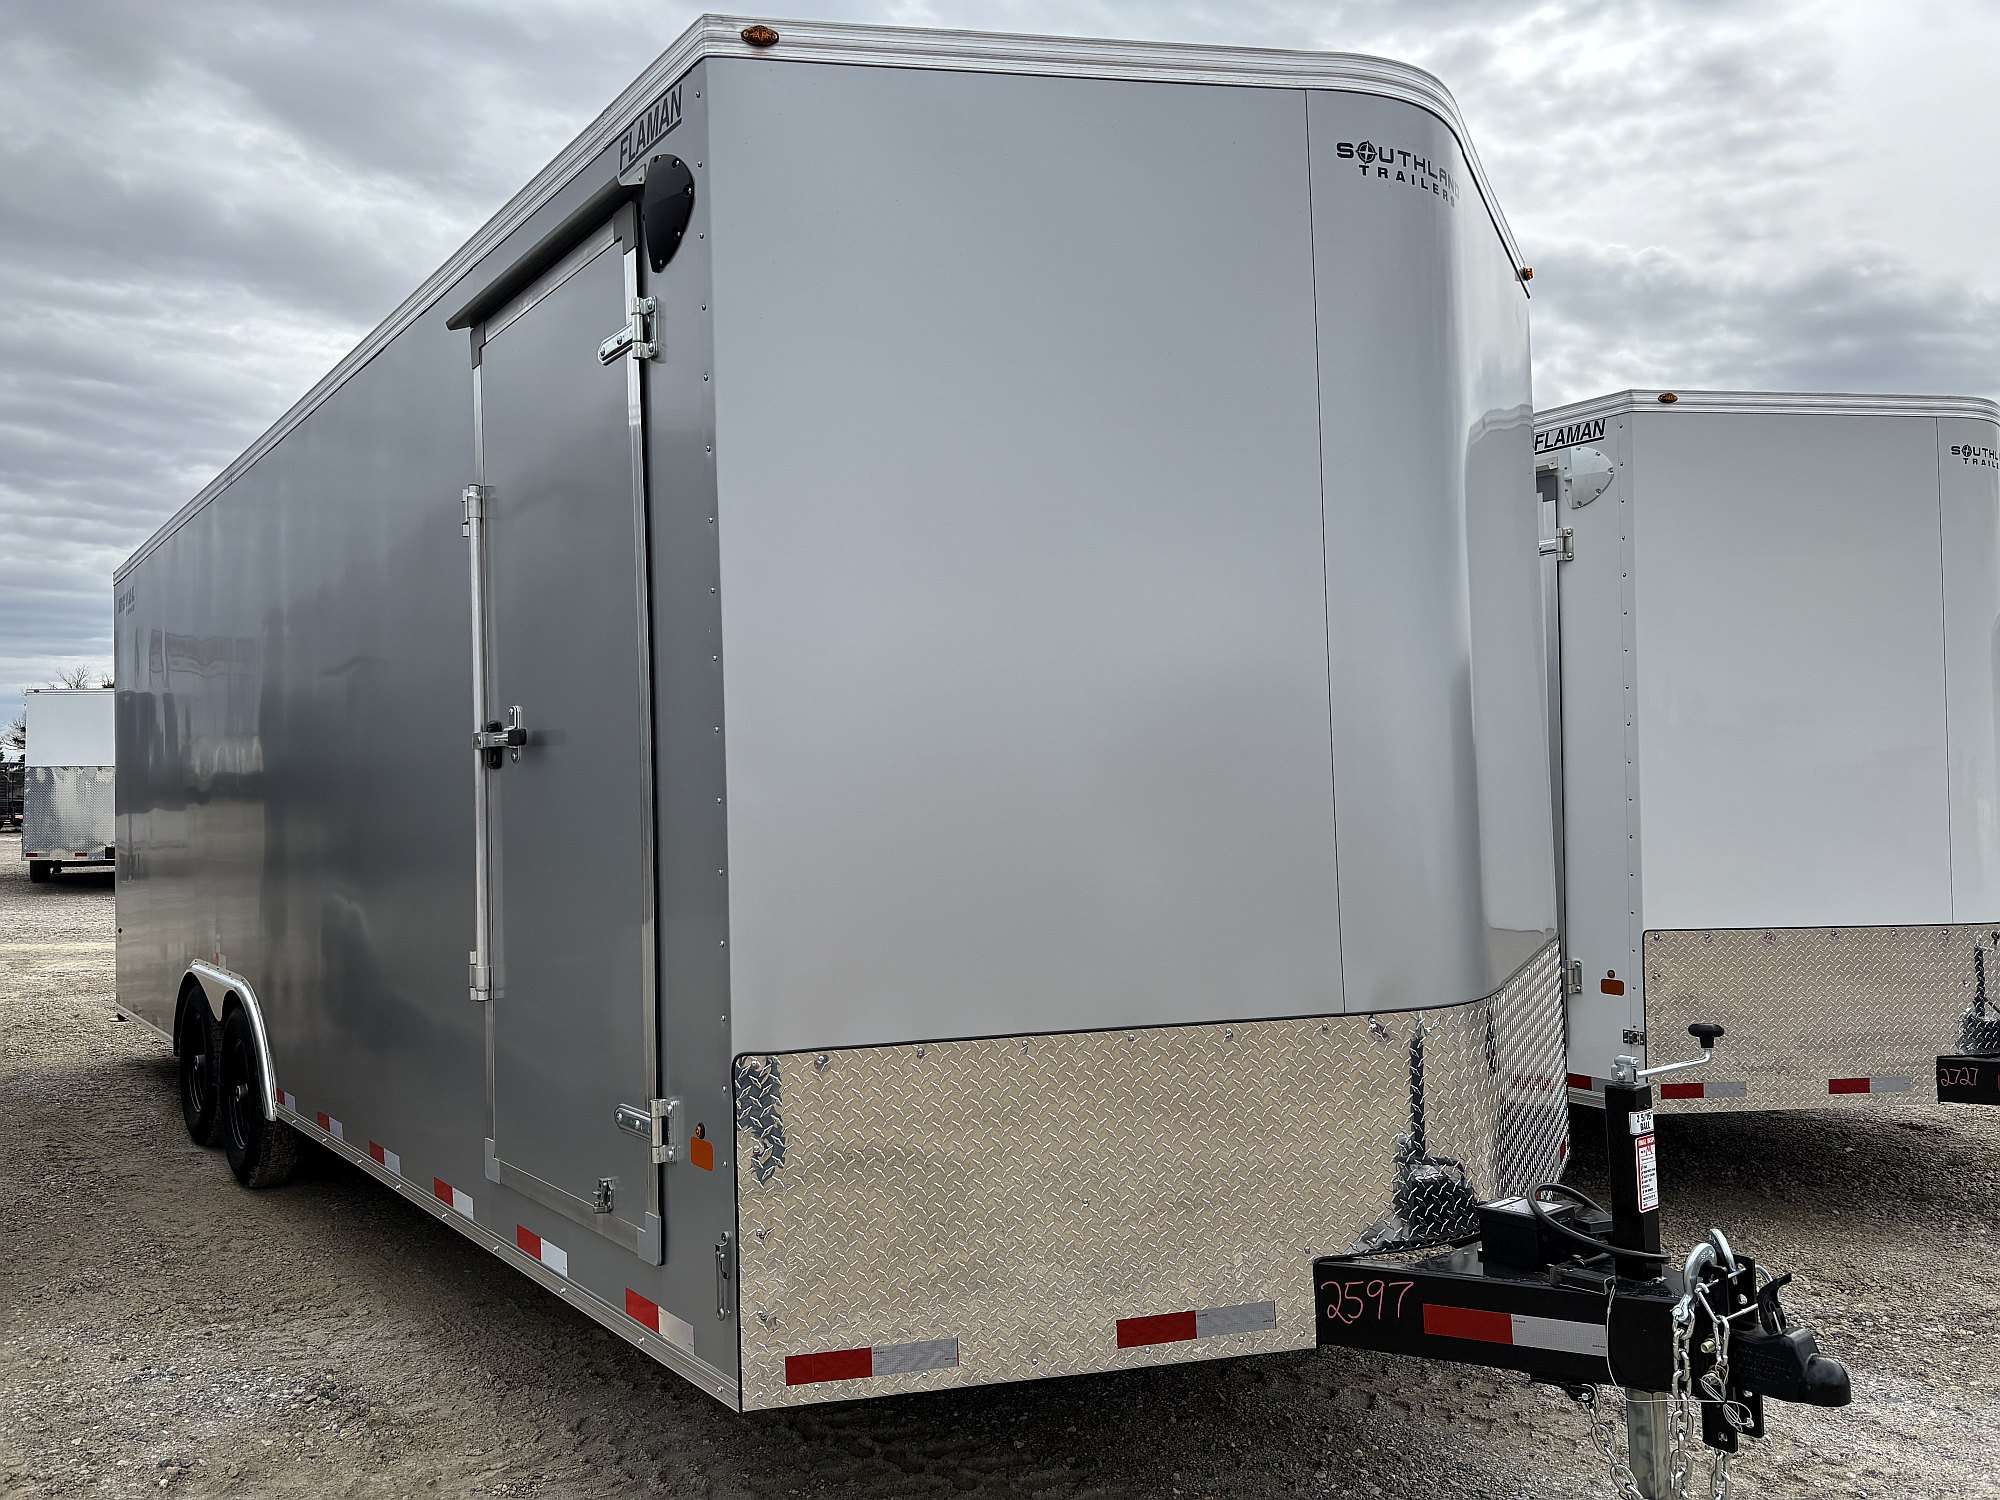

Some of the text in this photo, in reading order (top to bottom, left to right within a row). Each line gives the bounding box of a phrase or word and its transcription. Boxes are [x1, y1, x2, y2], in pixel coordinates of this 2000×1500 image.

[619, 85, 683, 171] FLAMAN
[1336, 141, 1460, 200] SOUTHLAND
[1358, 164, 1455, 207] TRAILERS
[1534, 418, 1606, 451] FLAMAN
[1951, 443, 2000, 461] SOUTHL
[1939, 1066, 1980, 1087] 2727
[1320, 1279, 1415, 1325] 2597
